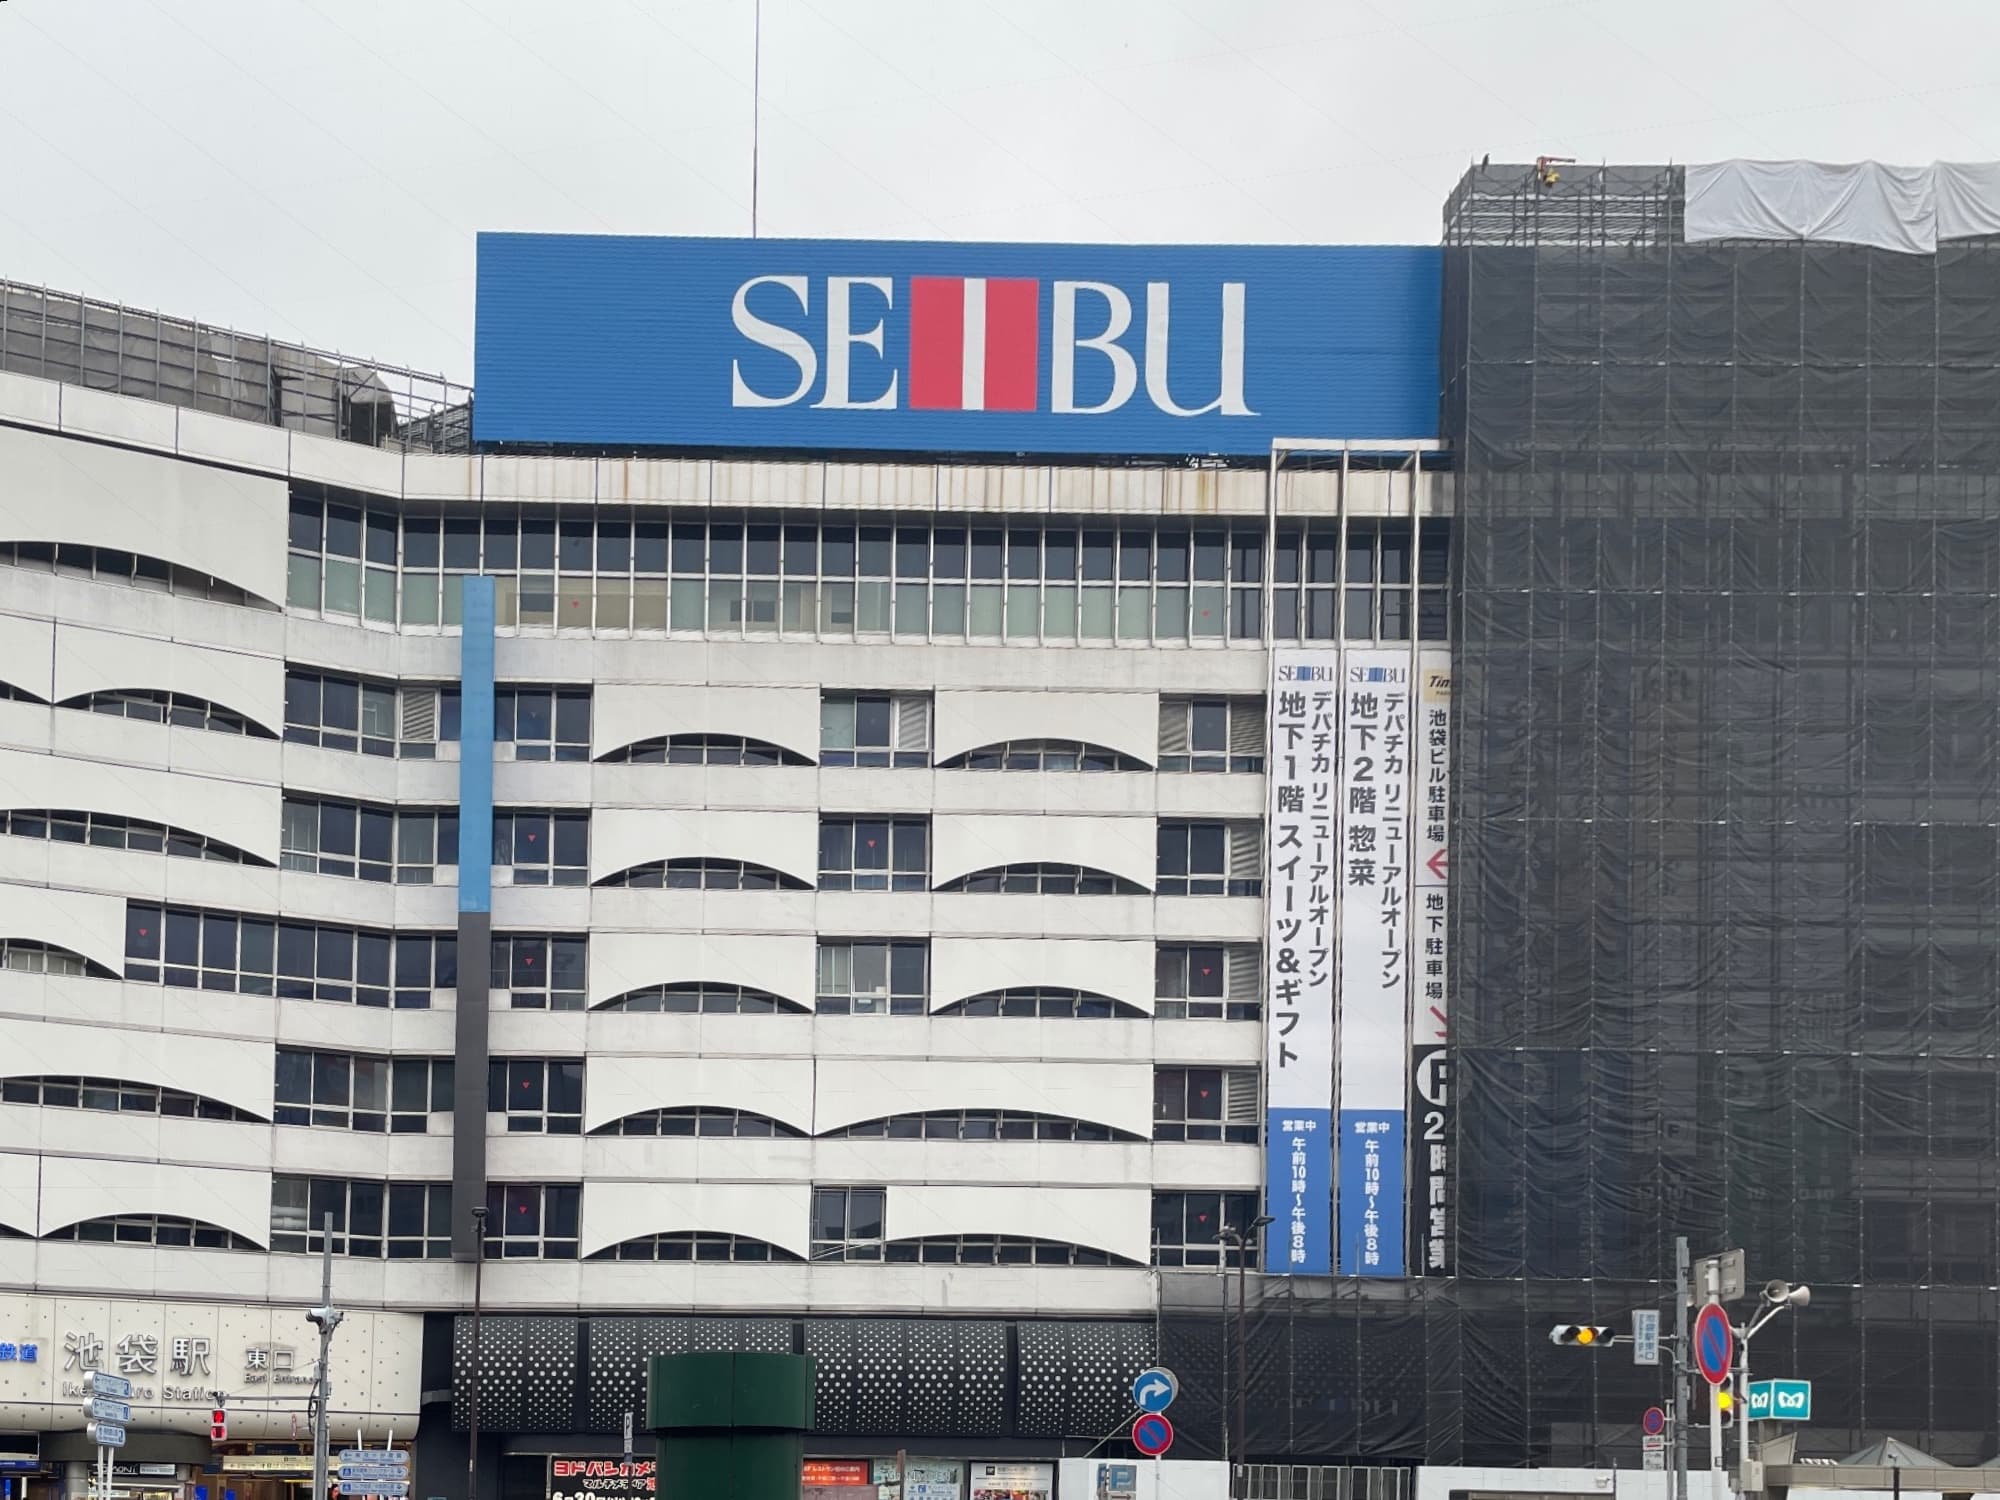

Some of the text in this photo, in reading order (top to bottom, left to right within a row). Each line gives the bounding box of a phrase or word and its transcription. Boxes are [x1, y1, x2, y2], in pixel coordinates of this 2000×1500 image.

[731, 275, 1262, 417] SEIBU
[1278, 665, 1333, 682] SEIBU
[1350, 667, 1406, 683] SEIBU
[1426, 709, 1447, 842] 池袋ビル駐車場
[1425, 894, 1444, 1000] 地下駐車場
[1282, 1120, 1317, 1132] 営業中
[1354, 1122, 1390, 1134] 営業中
[63, 1331, 296, 1376] 池袋駅 東口
[1115, 1471, 1132, 1489] P
